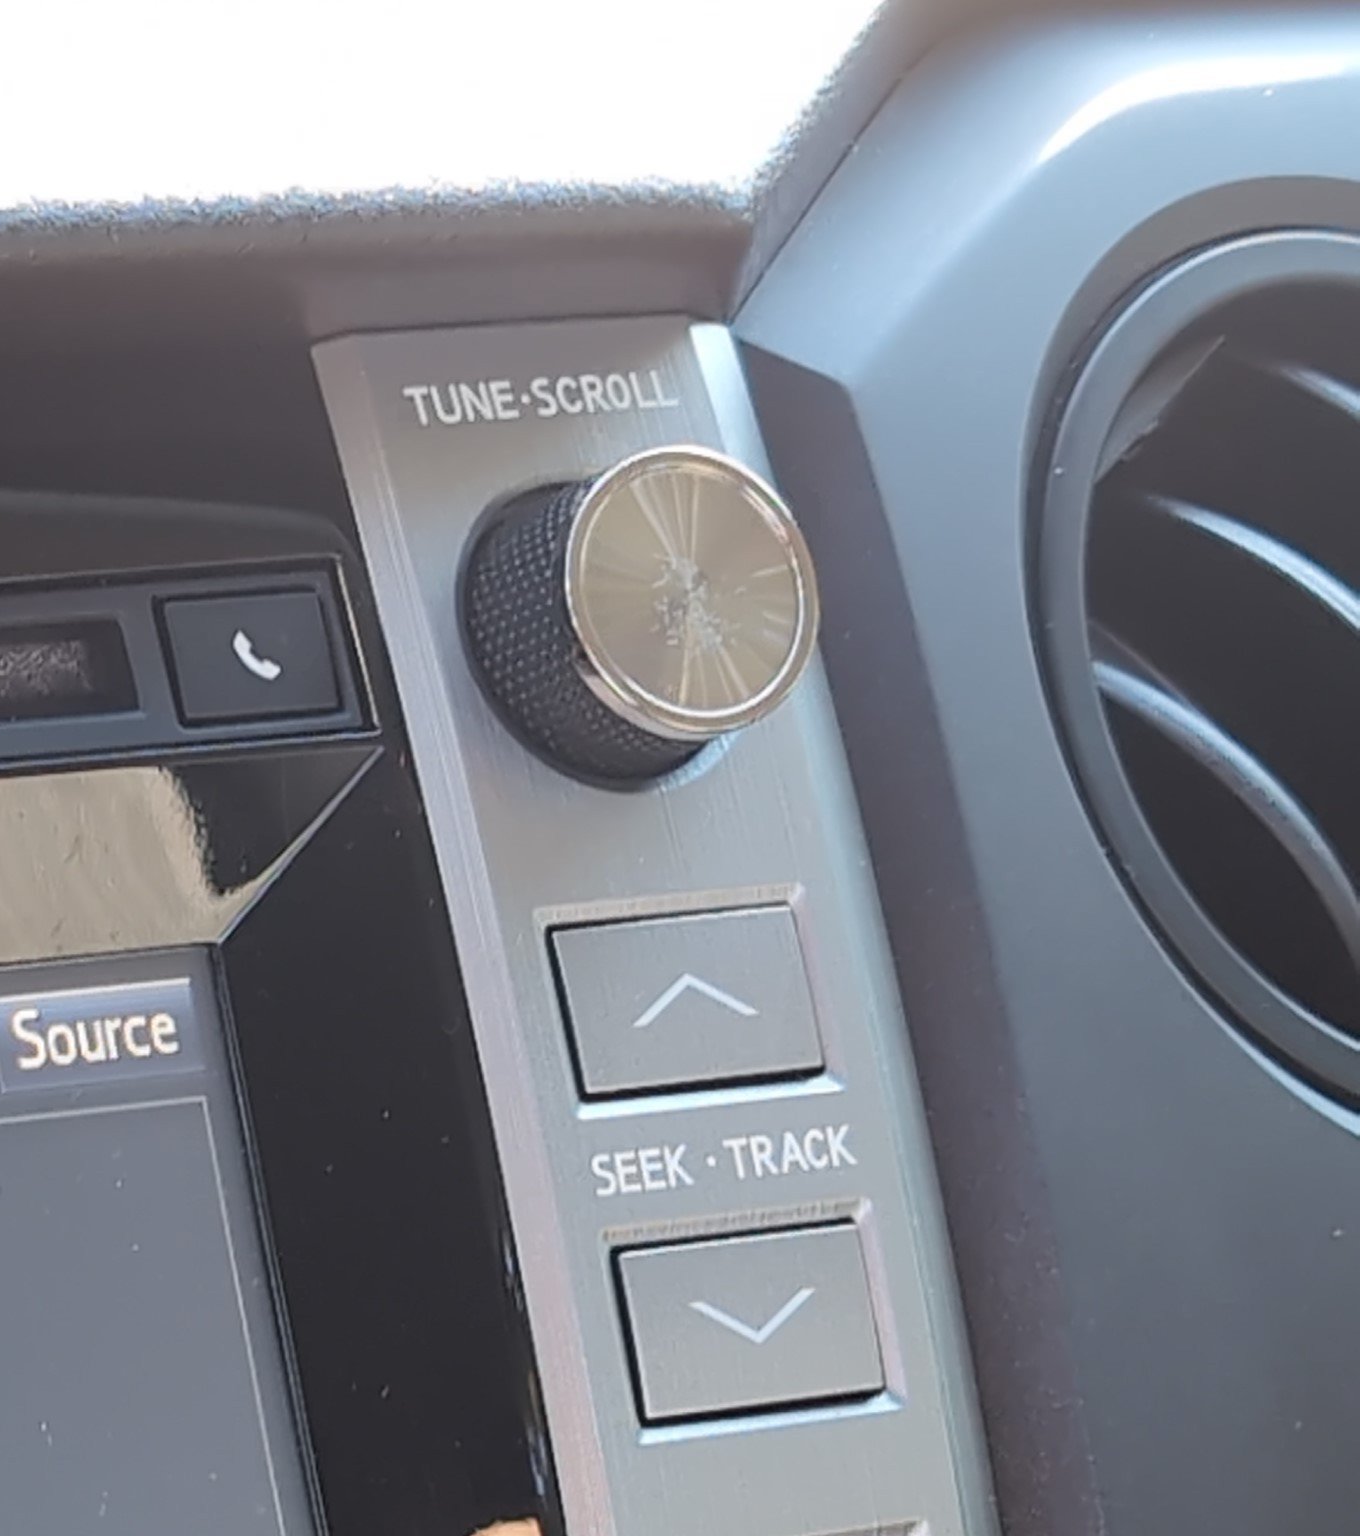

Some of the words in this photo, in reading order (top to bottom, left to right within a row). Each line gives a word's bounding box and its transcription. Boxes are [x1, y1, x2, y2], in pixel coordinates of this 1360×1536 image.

[10, 1009, 179, 1070] Source
[590, 1142, 694, 1196] SEEK
[724, 1125, 858, 1180] TRACK
